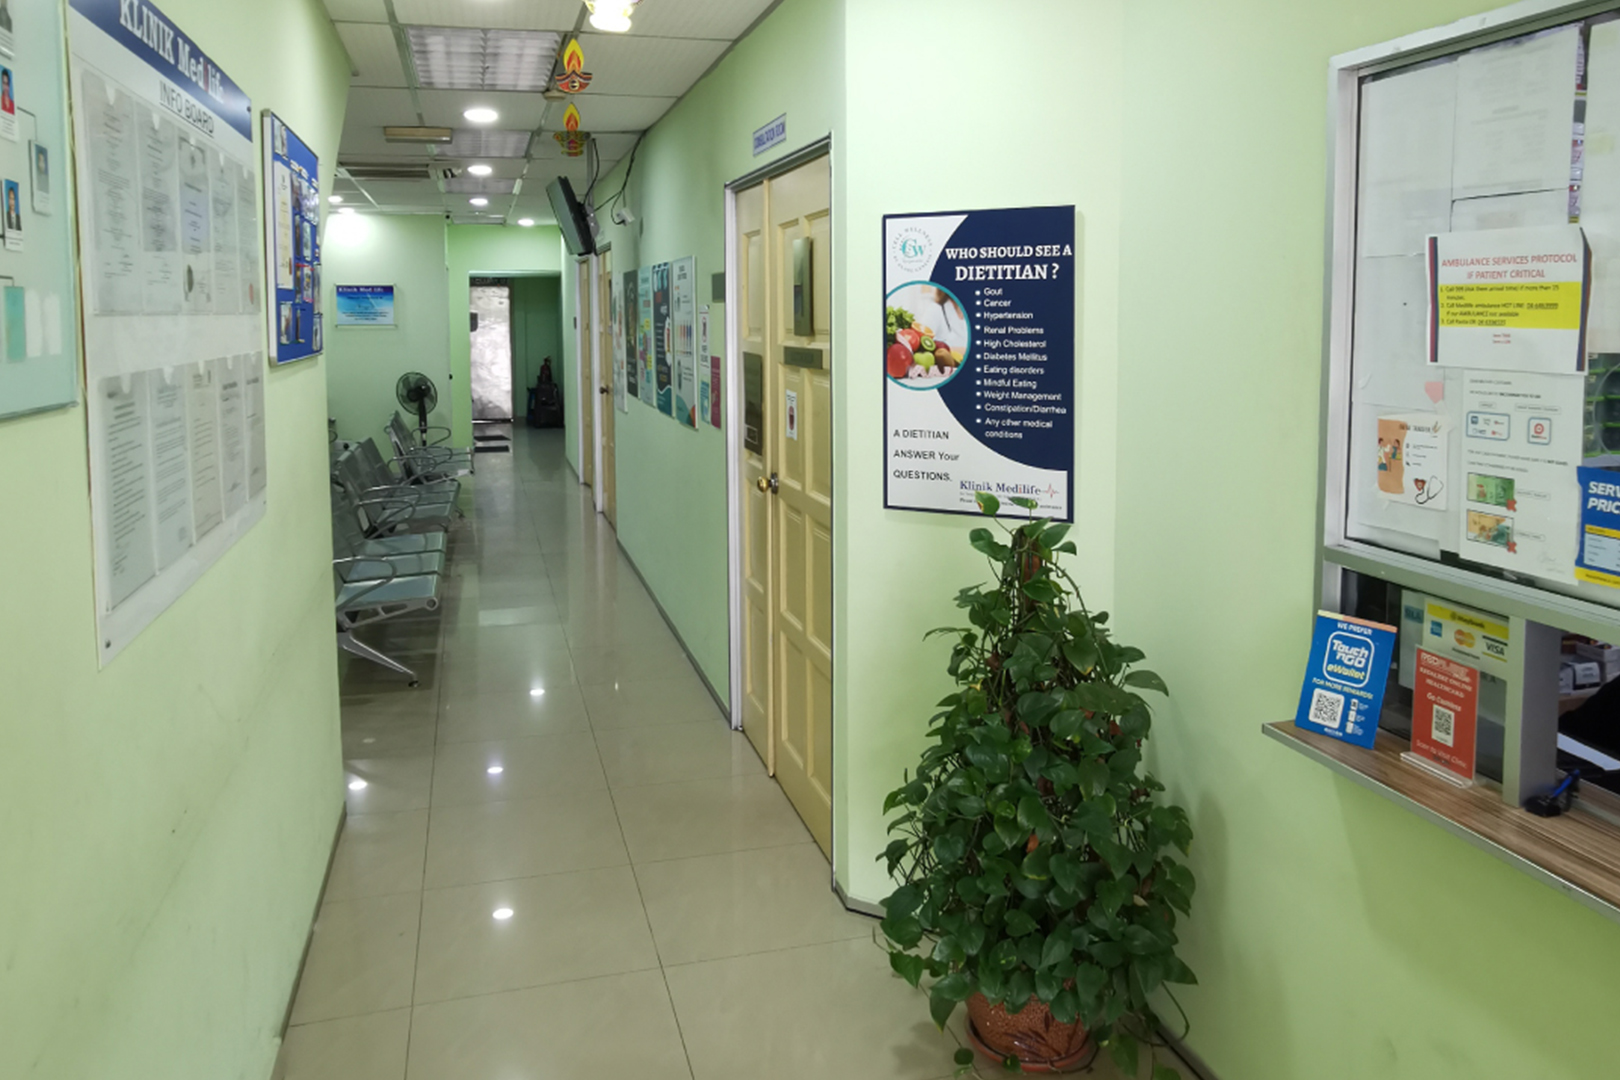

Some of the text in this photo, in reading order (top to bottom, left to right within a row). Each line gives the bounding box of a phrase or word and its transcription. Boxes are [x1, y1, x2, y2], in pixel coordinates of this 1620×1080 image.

[159, 80, 214, 134] INFO BOARD
[945, 244, 1072, 260] WHO SHOULD SEE A
[1441, 254, 1577, 267] AMBULANCE SERVICES PROTOCOL
[1467, 269, 1545, 280] IF PATIENT CRITICAL
[984, 287, 1003, 296] Gout
[984, 299, 1012, 307] Cancer
[984, 311, 1033, 321] Hypertension
[984, 326, 1044, 335] Renal Problems
[984, 339, 1046, 349] High Cholesterol
[984, 353, 1047, 361] Diabetes Mellitus
[984, 366, 1044, 375] Eating disorders
[984, 379, 1037, 389] Mindful Eating
[984, 390, 1062, 402] Weight Management
[984, 418, 1053, 428] Any other medical
[893, 430, 949, 440] A DIETITIAN
[985, 431, 1023, 439] conditions
[893, 450, 959, 461] ANSWER Your
[960, 480, 1041, 496] Klinik Medilife
[1337, 622, 1373, 635] WE PREFER
[1332, 639, 1369, 658] Touch
[1486, 642, 1505, 656] VISA
[1327, 664, 1365, 680] eWallet
[1312, 677, 1324, 685] FOR
[1325, 680, 1343, 691] MORE
